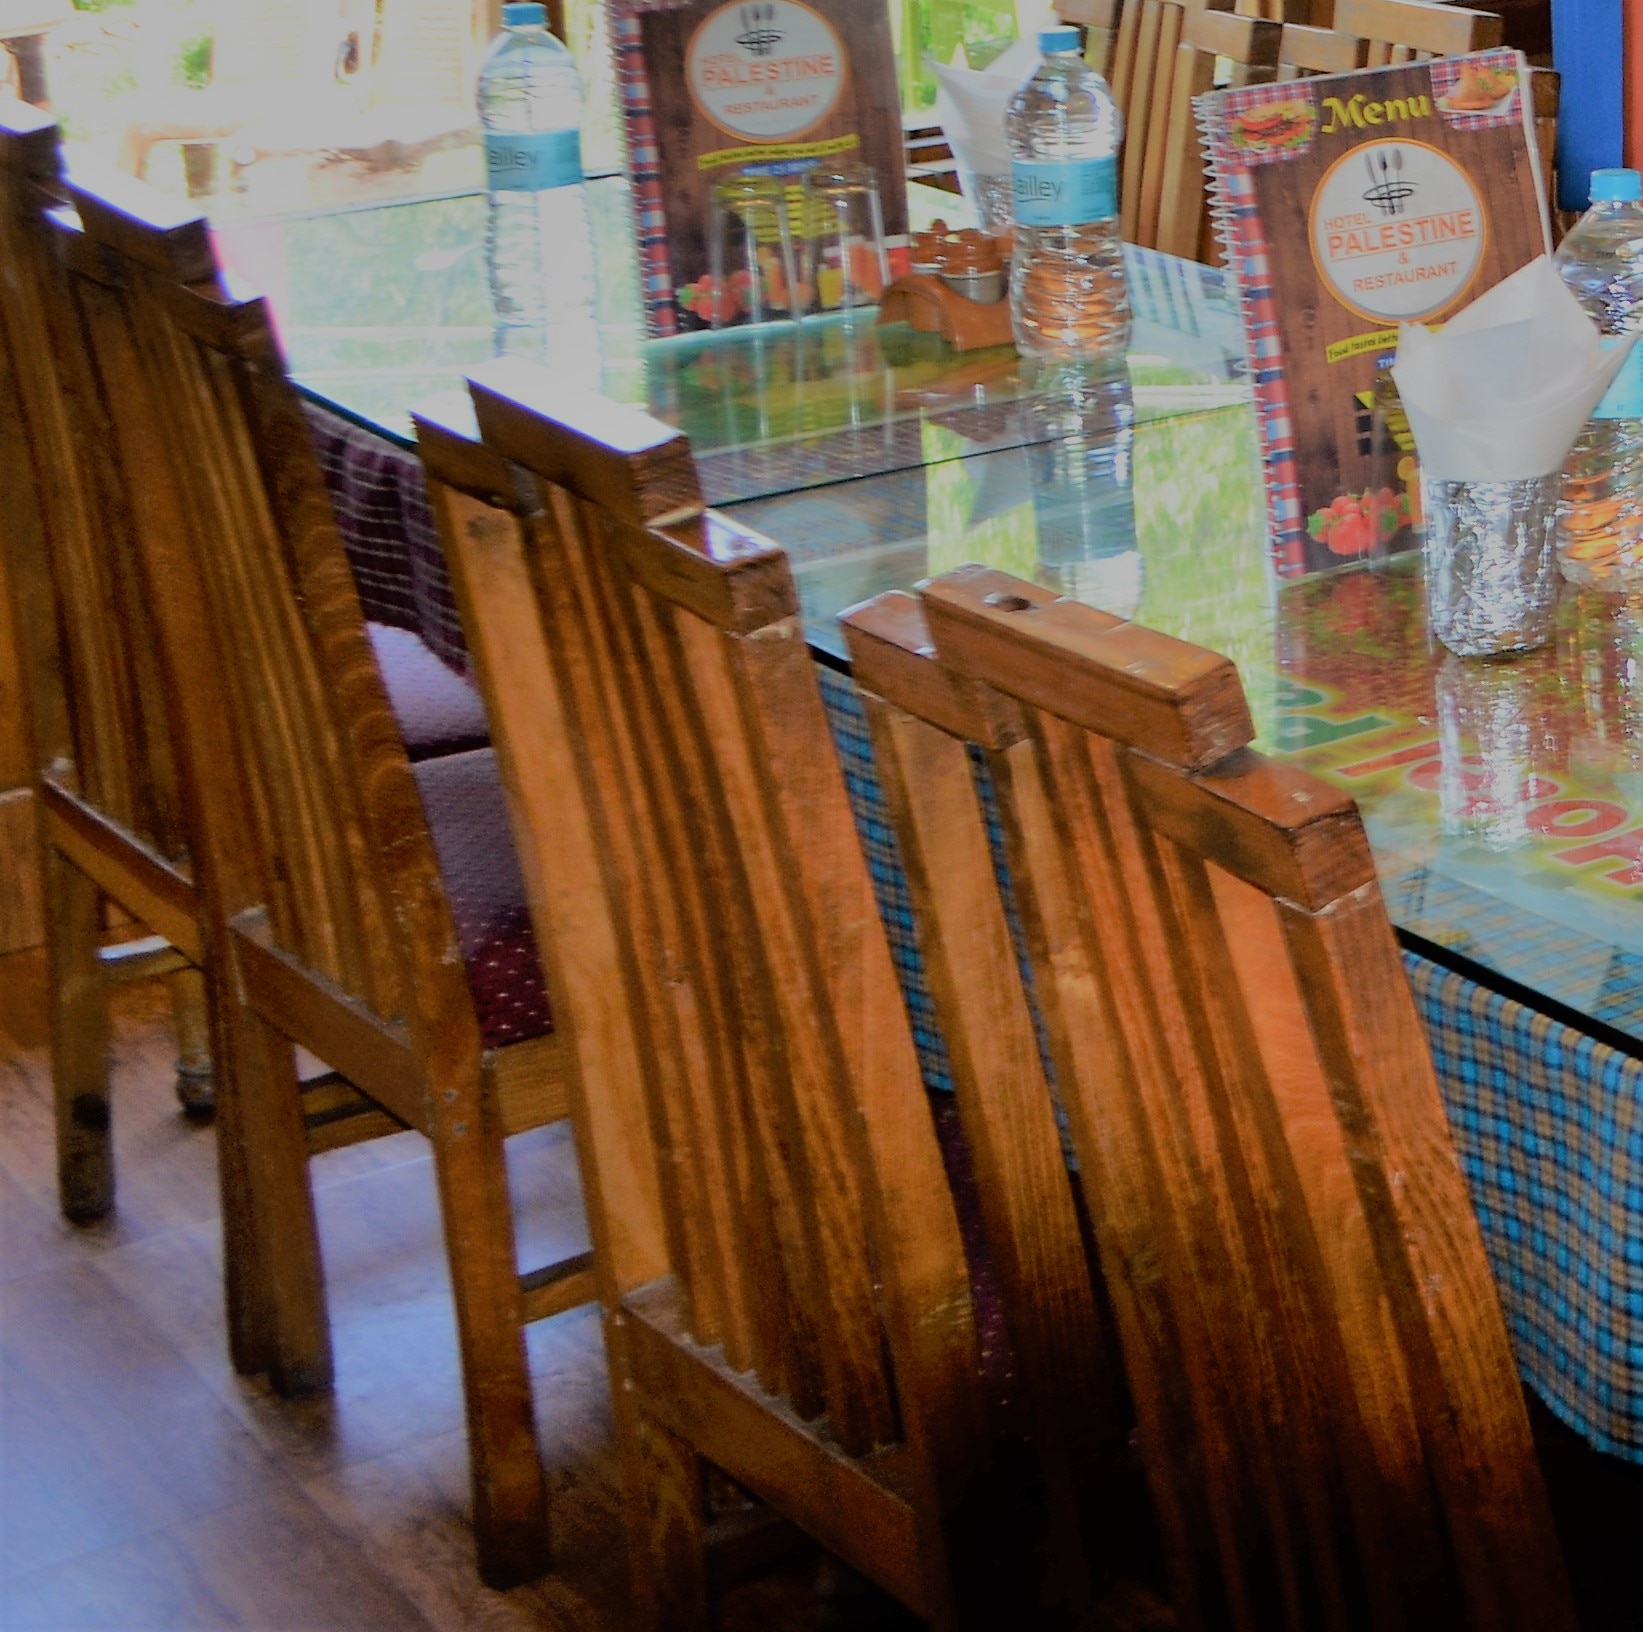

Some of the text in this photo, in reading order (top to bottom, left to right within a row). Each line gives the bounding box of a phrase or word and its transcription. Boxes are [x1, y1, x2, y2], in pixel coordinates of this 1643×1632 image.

[703, 55, 834, 83] PALESTINE
[1321, 94, 1431, 133] Menu
[1324, 212, 1372, 231] HOTEL
[1328, 211, 1475, 257] PALESTINE
[1398, 252, 1409, 264] &
[1353, 262, 1457, 292] RESTAURANT
